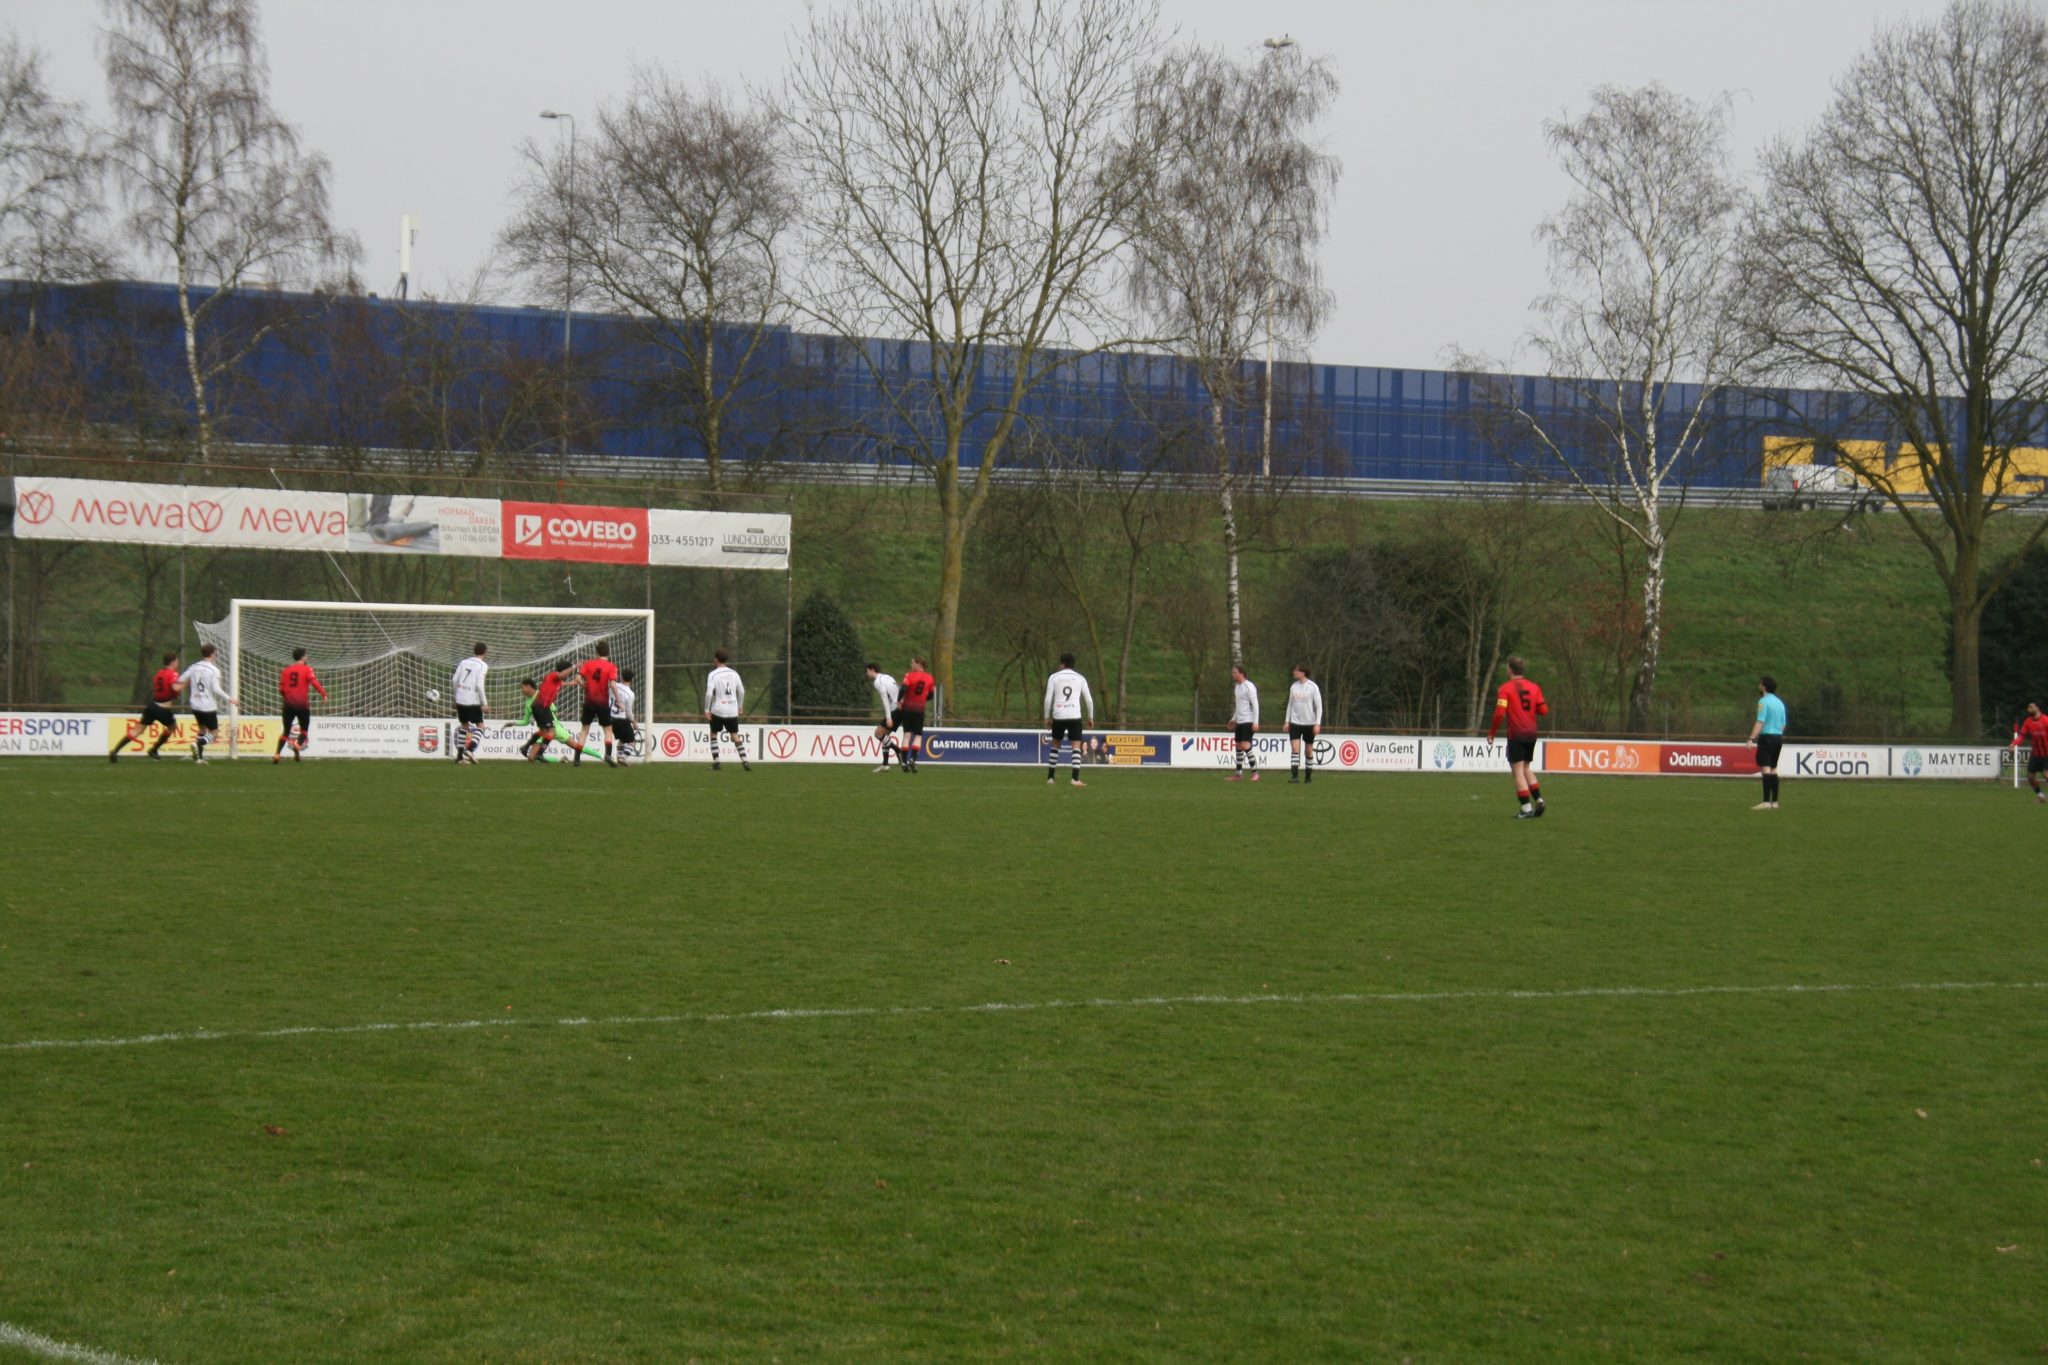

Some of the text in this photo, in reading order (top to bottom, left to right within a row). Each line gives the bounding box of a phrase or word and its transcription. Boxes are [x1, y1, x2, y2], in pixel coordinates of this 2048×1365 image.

[547, 518, 637, 541] COVEBO
[651, 535, 715, 548] 033-4551217
[463, 668, 472, 684] 7
[592, 667, 602, 681] 4
[197, 681, 205, 692] 6
[1062, 686, 1073, 702] 9
[149, 723, 183, 738] BN
[317, 722, 366, 731] SUPPORTERS
[482, 728, 535, 742] Cafetari
[29, 739, 63, 751] DAM
[482, 746, 500, 754] voor
[932, 740, 1018, 750] BASTION HOTELS.COM
[1196, 737, 1288, 753] INTERPORT
[1366, 742, 1415, 756] Van Gent
[1462, 745, 1508, 758] MAYT
[1567, 748, 1610, 769] ING
[1829, 751, 1868, 759] LIFTEN
[1928, 752, 1991, 766] MAYTREE
[1795, 752, 1869, 775] Kroon
